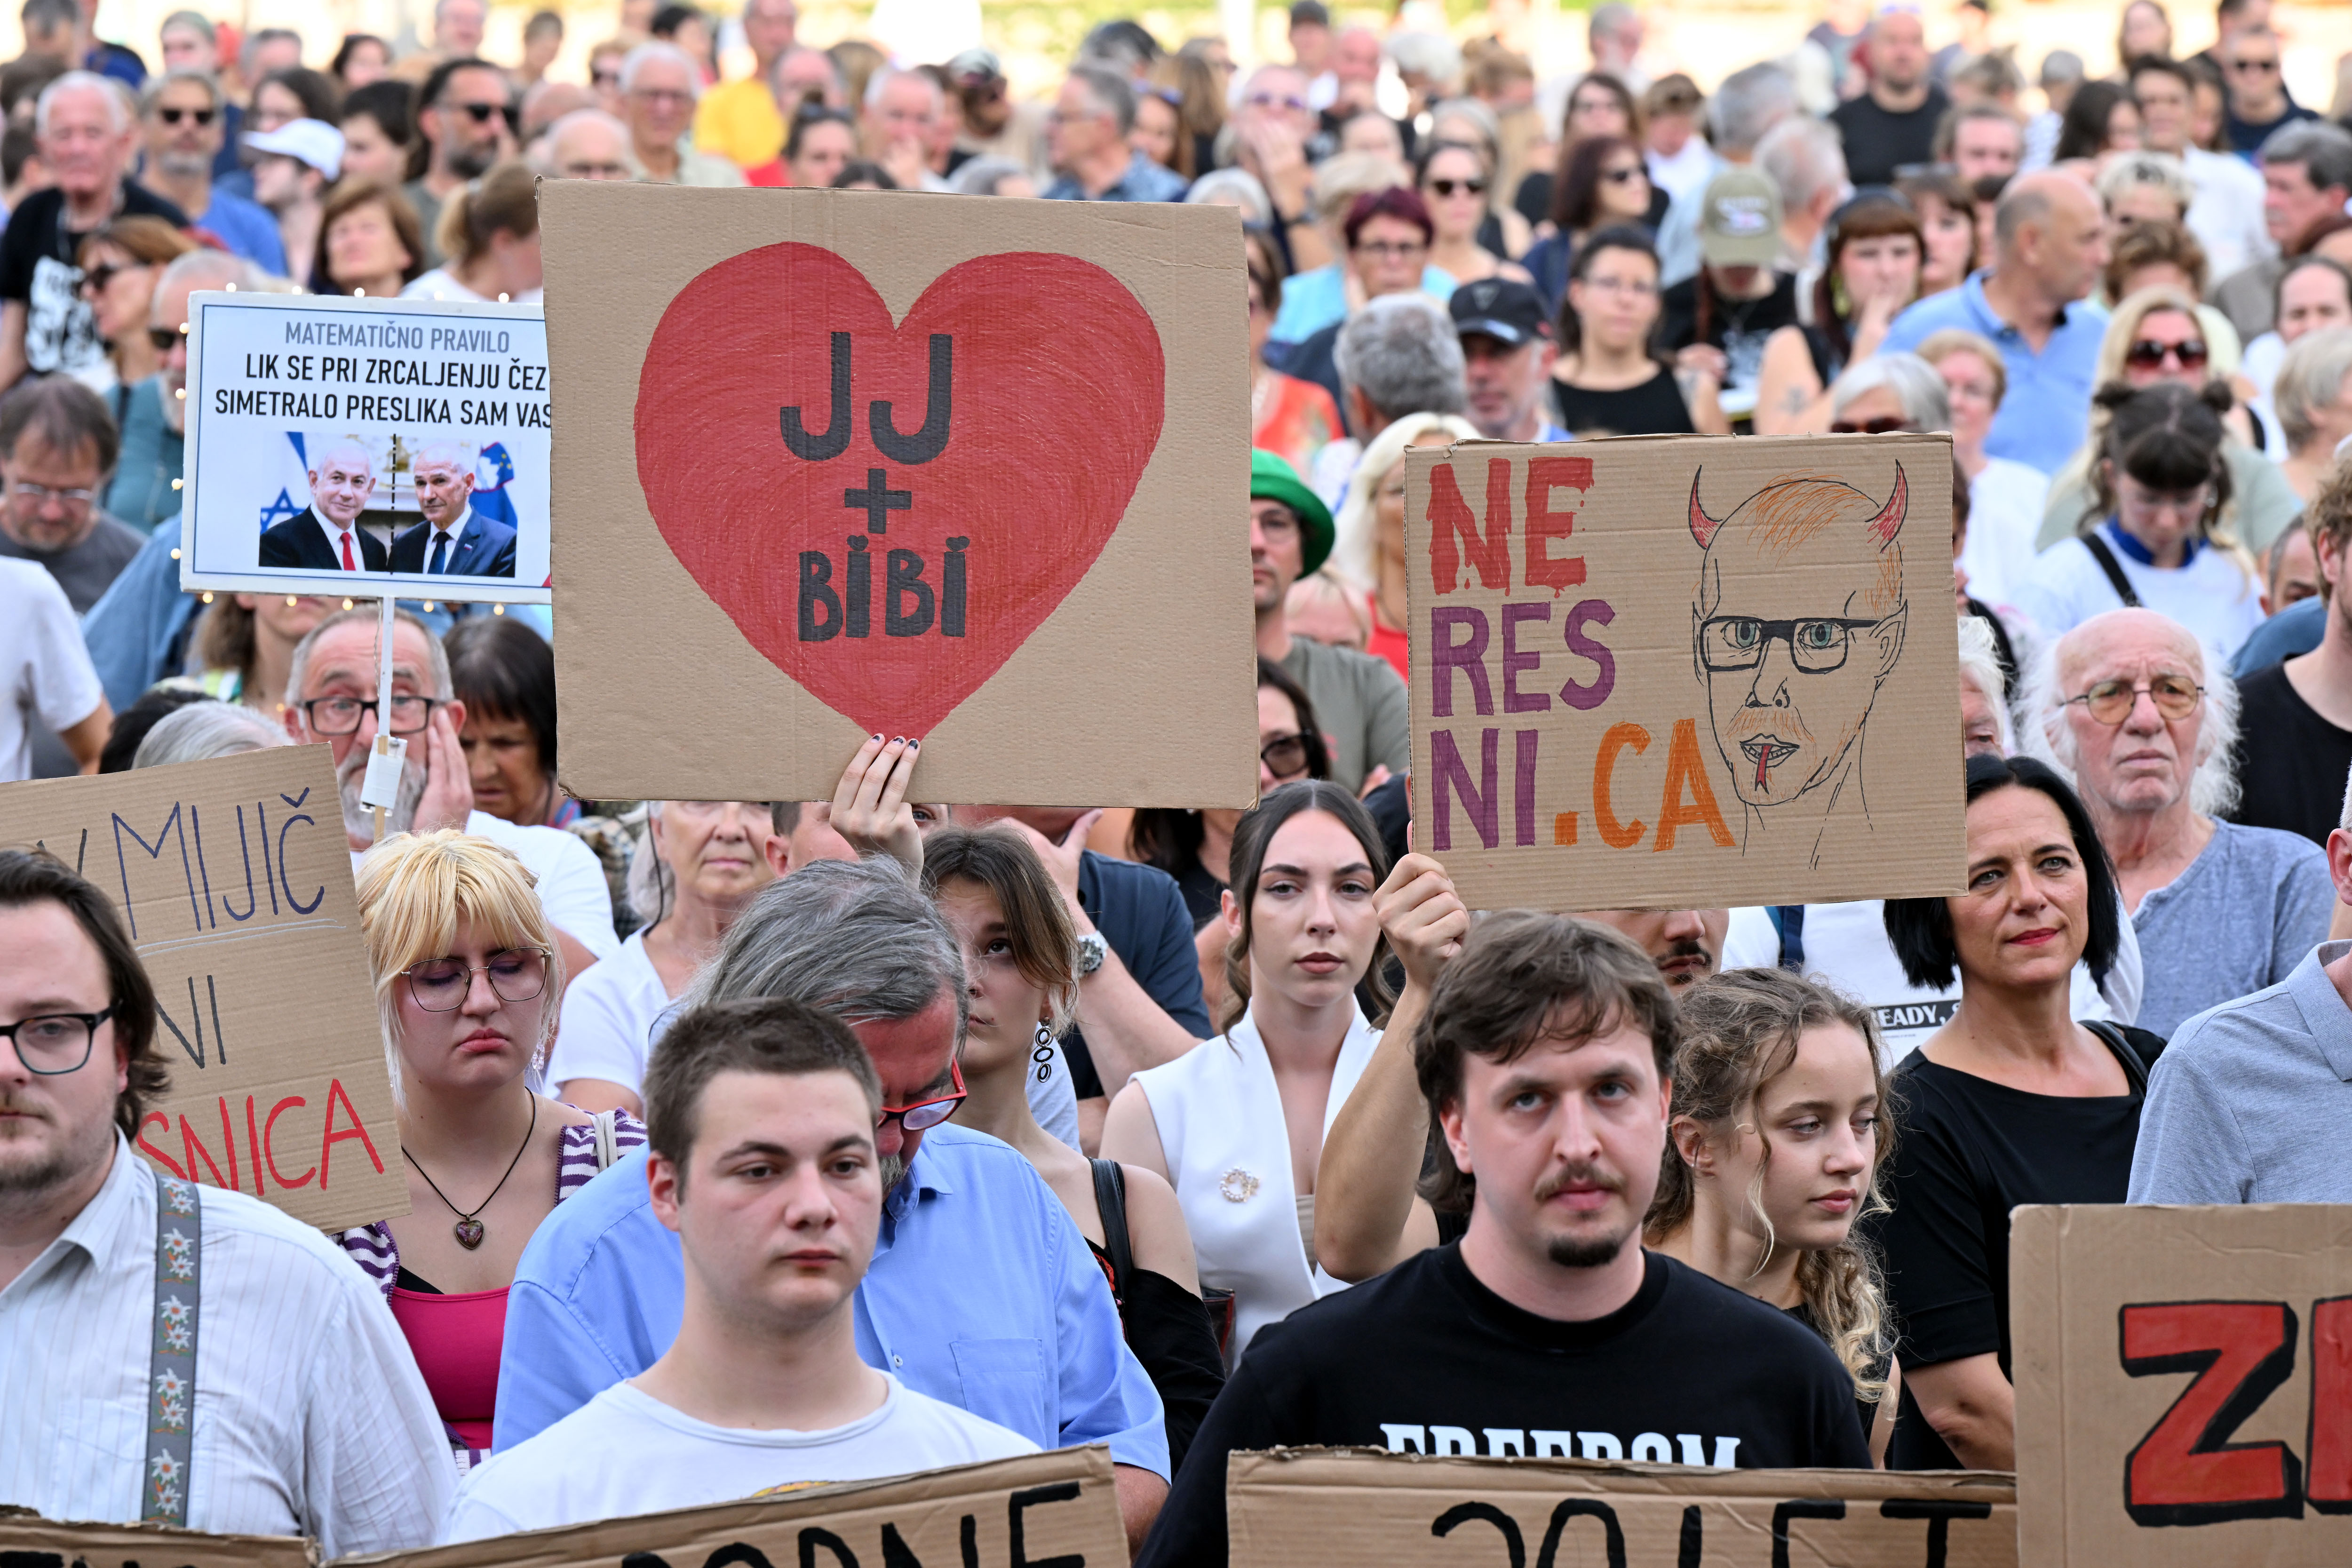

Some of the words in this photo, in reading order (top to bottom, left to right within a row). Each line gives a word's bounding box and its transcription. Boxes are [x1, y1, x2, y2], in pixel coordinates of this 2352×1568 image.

[286, 320, 423, 350] MATEMATIČNO
[431, 328, 509, 353] PRAVILO
[246, 353, 279, 380] LIK
[287, 355, 314, 381] SE
[322, 356, 358, 383] PRI
[365, 358, 500, 390] ZRCALJENJU
[508, 357, 547, 391] ČEZ
[215, 389, 338, 419] SIMETRALO
[346, 394, 452, 424] PRESLIKA
[460, 399, 508, 427] SAM
[1426, 456, 1595, 598] NE
[1431, 599, 1616, 717] RES
